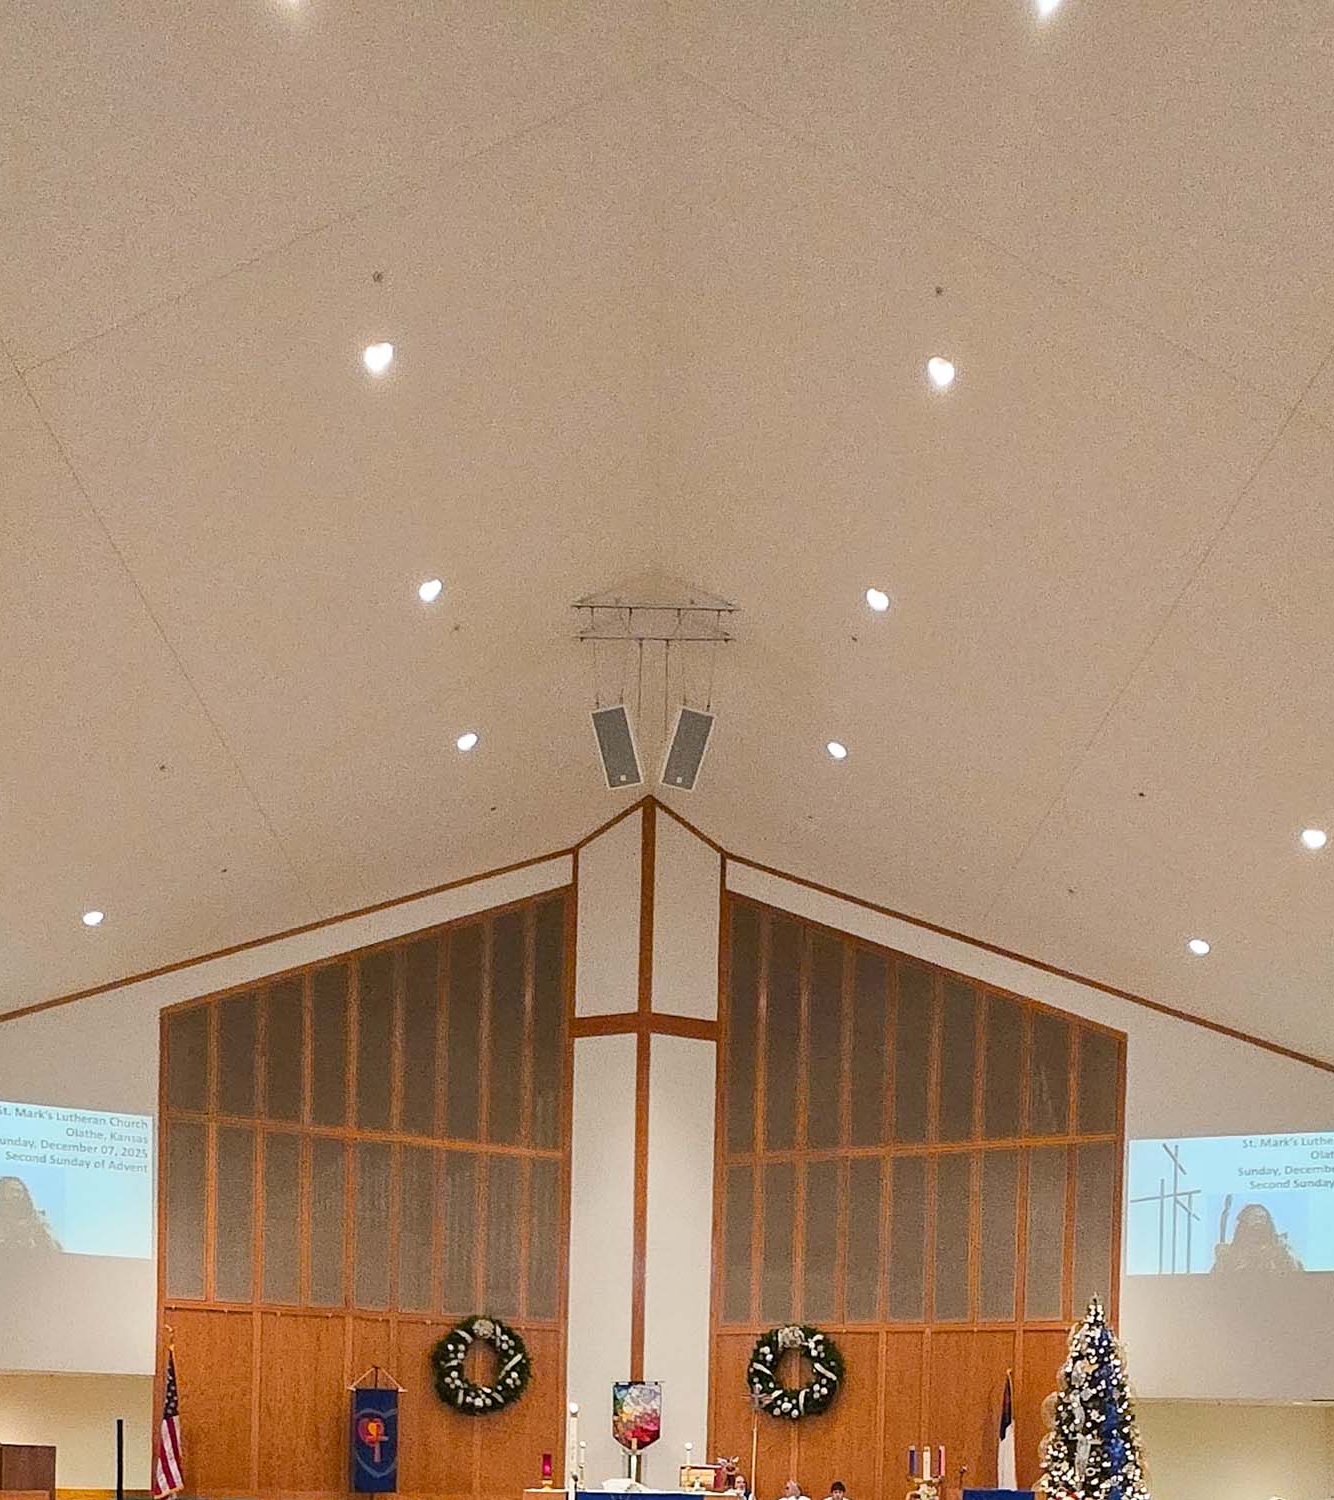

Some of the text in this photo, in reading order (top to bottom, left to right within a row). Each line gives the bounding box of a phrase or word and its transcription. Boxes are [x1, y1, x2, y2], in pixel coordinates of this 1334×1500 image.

[14, 1107, 54, 1120] Mark's
[56, 1112, 106, 1125] Lutheran
[109, 1116, 148, 1129] Church
[110, 1131, 148, 1144] Kansas
[1242, 1138, 1258, 1148] St.
[1260, 1136, 1298, 1147] Mark's
[41, 1139, 98, 1152] December
[121, 1146, 148, 1158] 2025
[4, 1151, 148, 1173] Second Sunday of Advent
[1237, 1165, 1282, 1177] Sunday,
[1249, 1179, 1291, 1190] Second
